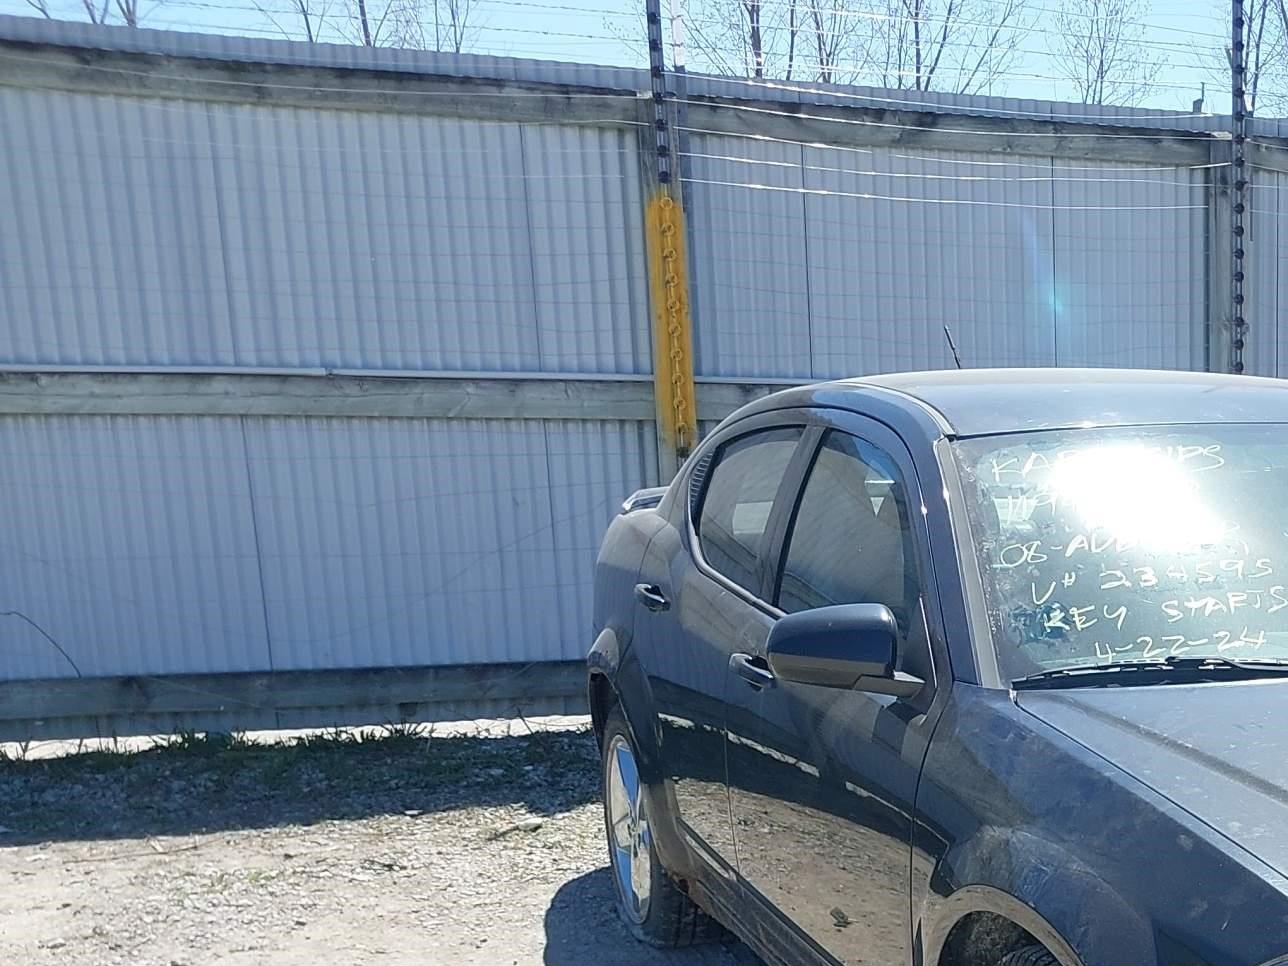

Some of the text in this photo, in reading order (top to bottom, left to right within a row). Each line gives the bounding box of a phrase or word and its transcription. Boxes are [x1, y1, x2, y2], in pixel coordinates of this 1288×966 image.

[1099, 558, 1273, 590] 234595
[1044, 605, 1127, 633] KEY
[1095, 626, 1266, 662] 4-22-24
